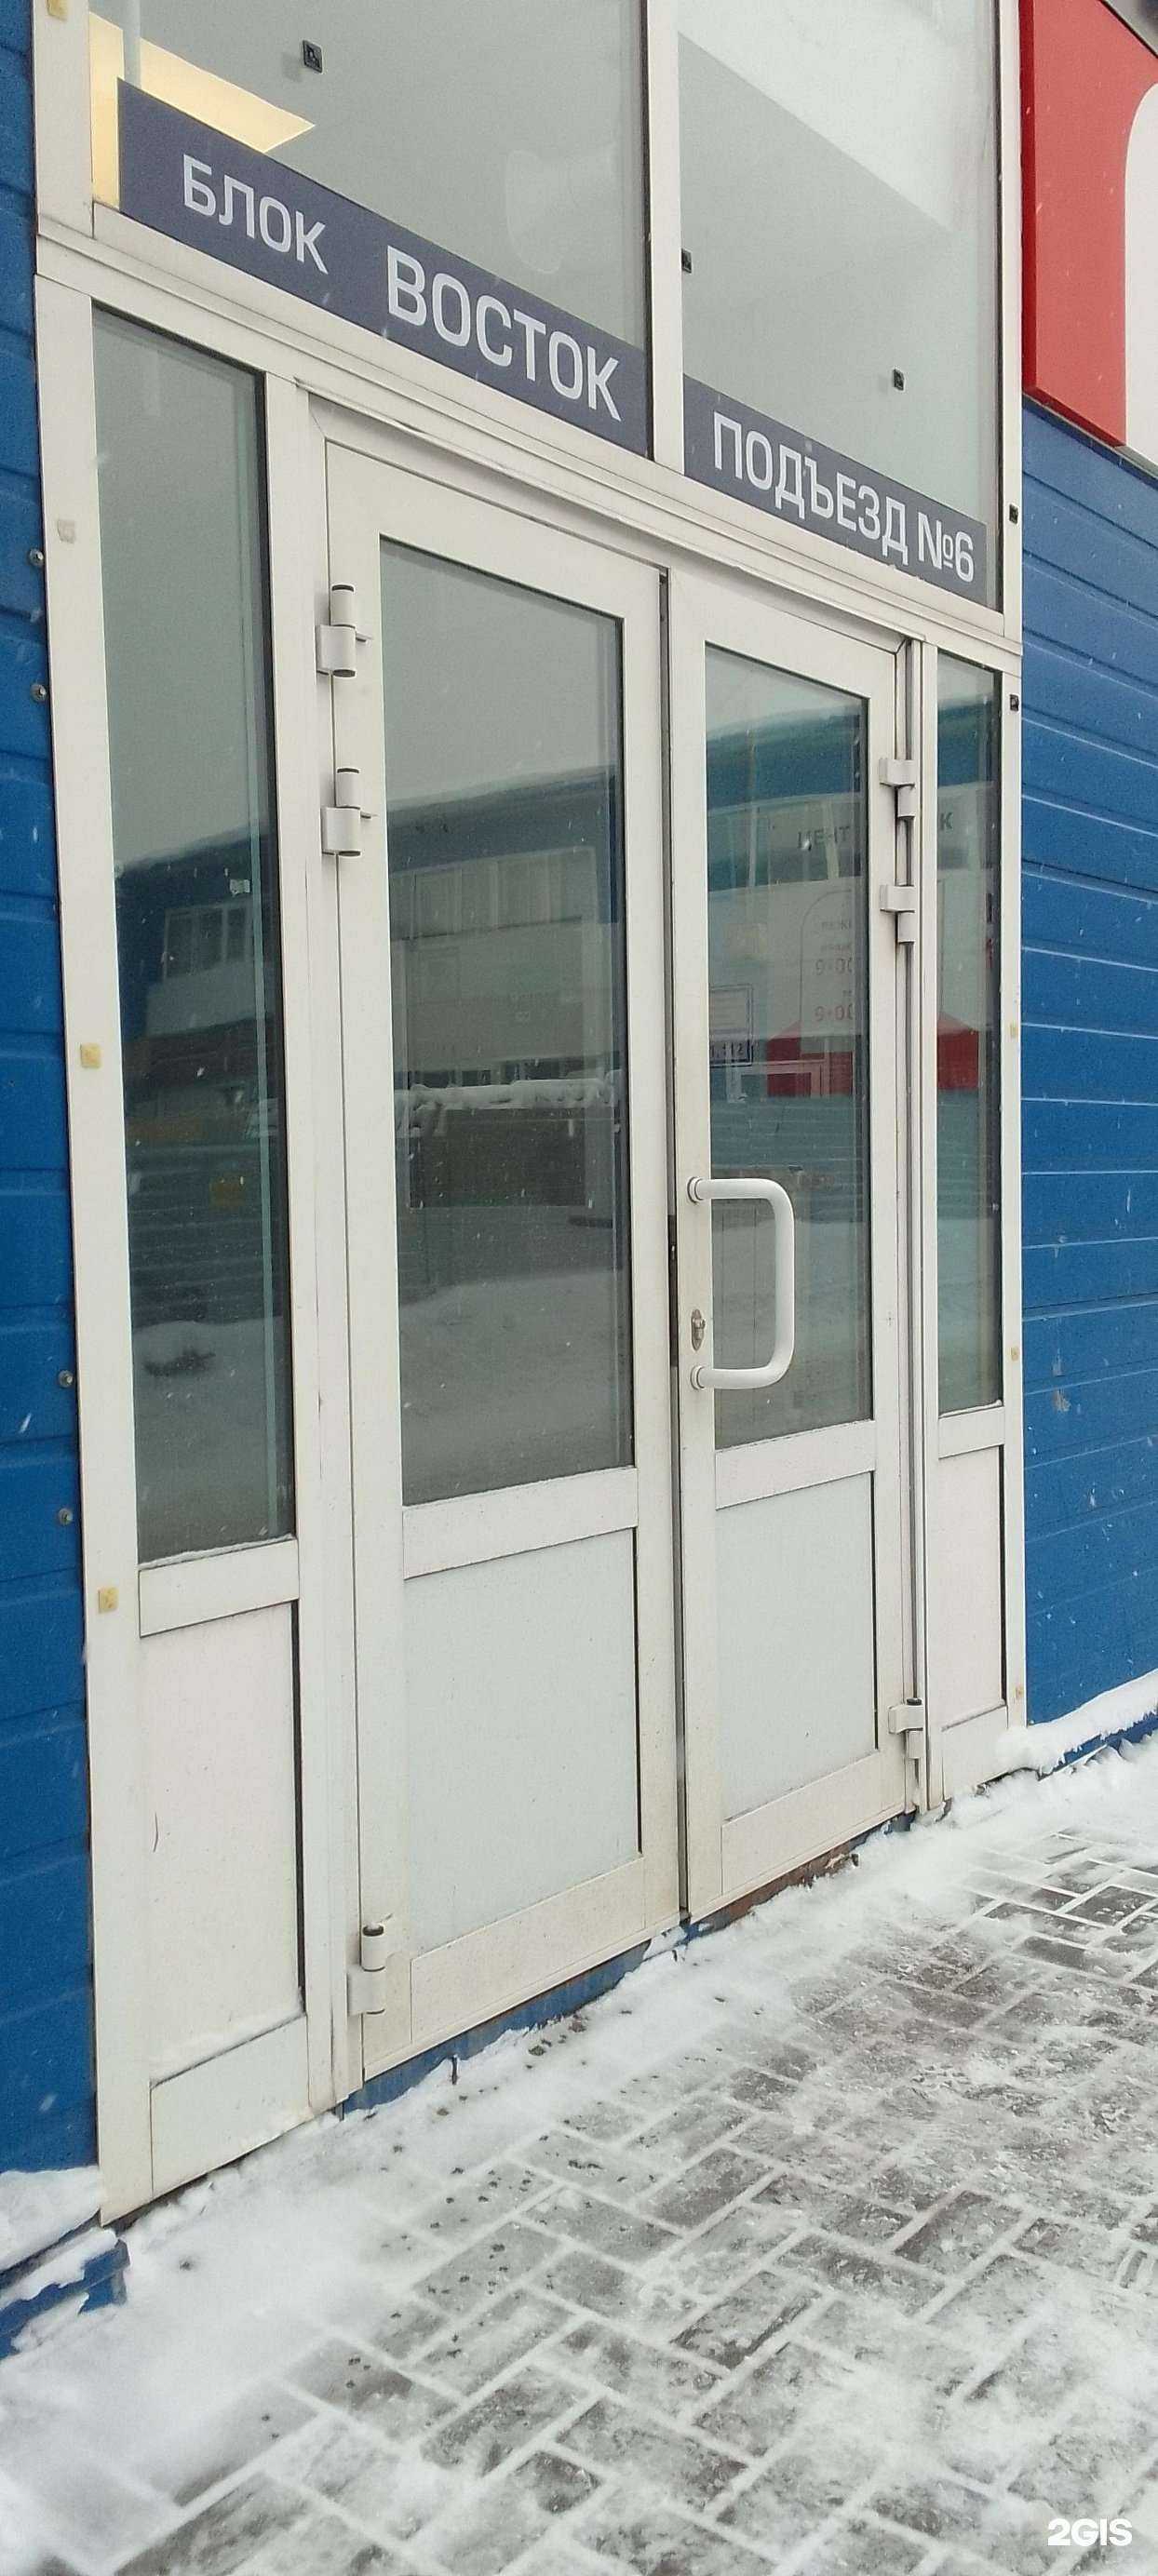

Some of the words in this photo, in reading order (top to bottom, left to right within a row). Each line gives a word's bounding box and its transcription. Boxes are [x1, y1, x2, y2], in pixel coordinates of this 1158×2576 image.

[182, 153, 329, 275] БЛОК
[386, 244, 622, 423] ВОСТОК
[713, 410, 909, 567] ПОДЪЕЗД
[917, 511, 975, 584] №6
